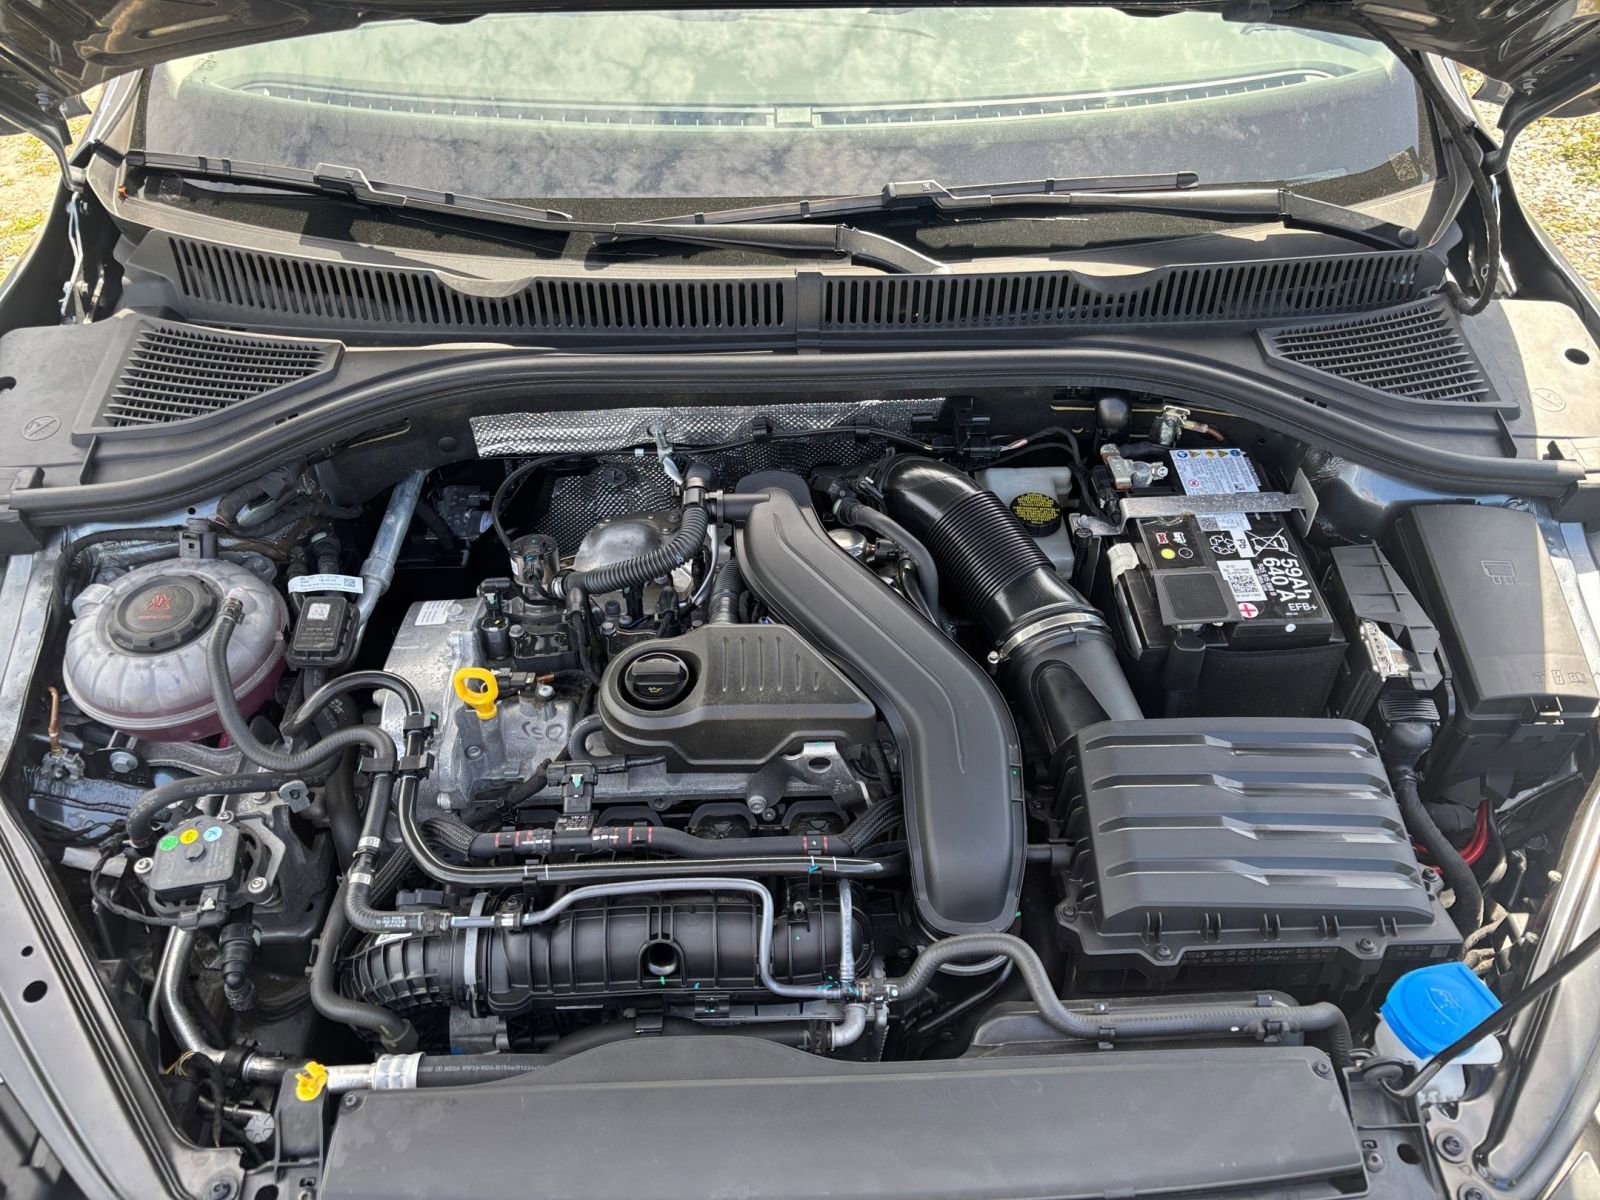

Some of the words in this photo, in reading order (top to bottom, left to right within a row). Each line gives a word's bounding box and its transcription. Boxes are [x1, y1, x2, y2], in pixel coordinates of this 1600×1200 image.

[1237, 538, 1247, 549] Pb
[1262, 557, 1289, 586] 640
[1276, 588, 1296, 602] A
[1281, 557, 1312, 600] 59Ah
[1287, 602, 1318, 611] EFB+
